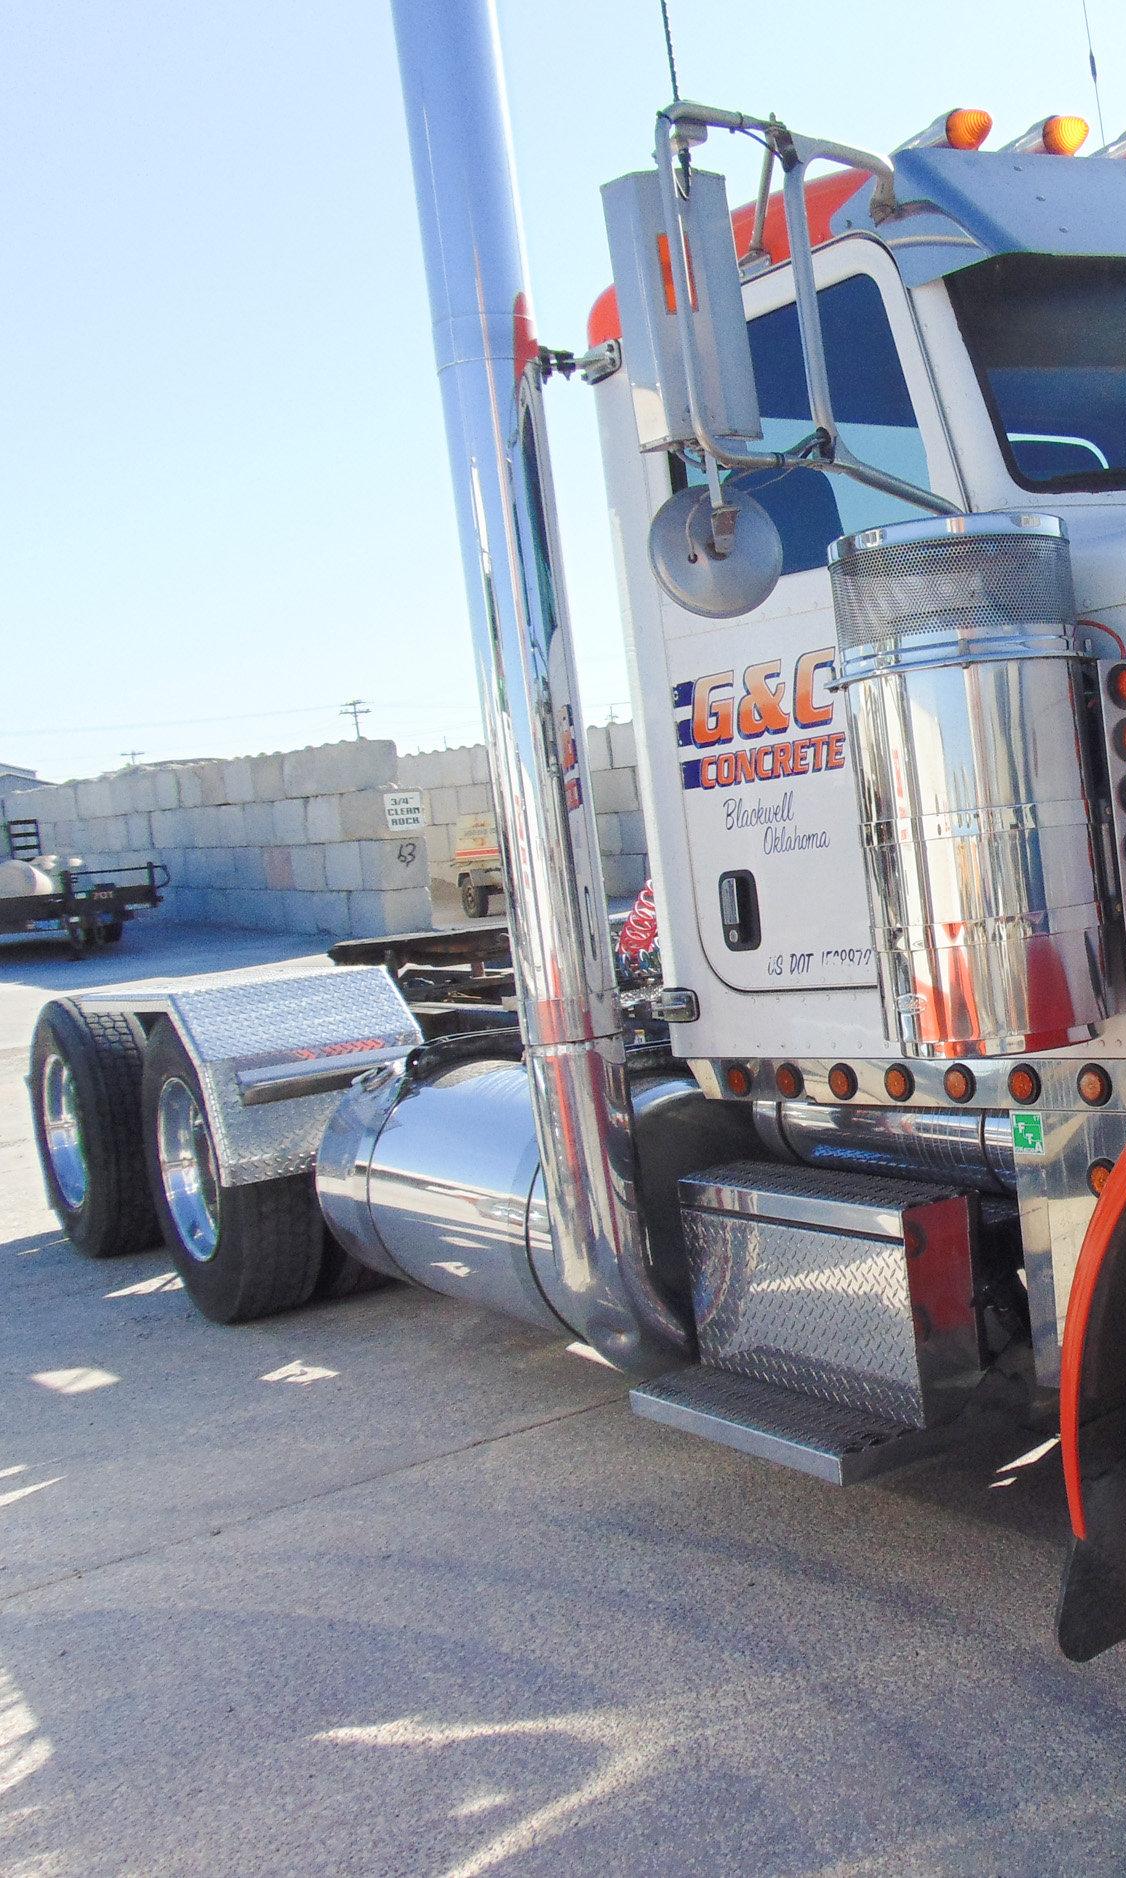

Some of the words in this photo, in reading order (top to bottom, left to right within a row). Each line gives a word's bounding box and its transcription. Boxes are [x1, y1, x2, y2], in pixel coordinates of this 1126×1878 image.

[691, 646, 837, 750] G&C
[700, 731, 847, 790] CONCRETE
[387, 806, 421, 817] CLEAN
[391, 817, 421, 826] ROCK
[722, 790, 795, 831] Blackwell
[763, 825, 831, 855] Oklahoma
[789, 952, 815, 976] DOT
